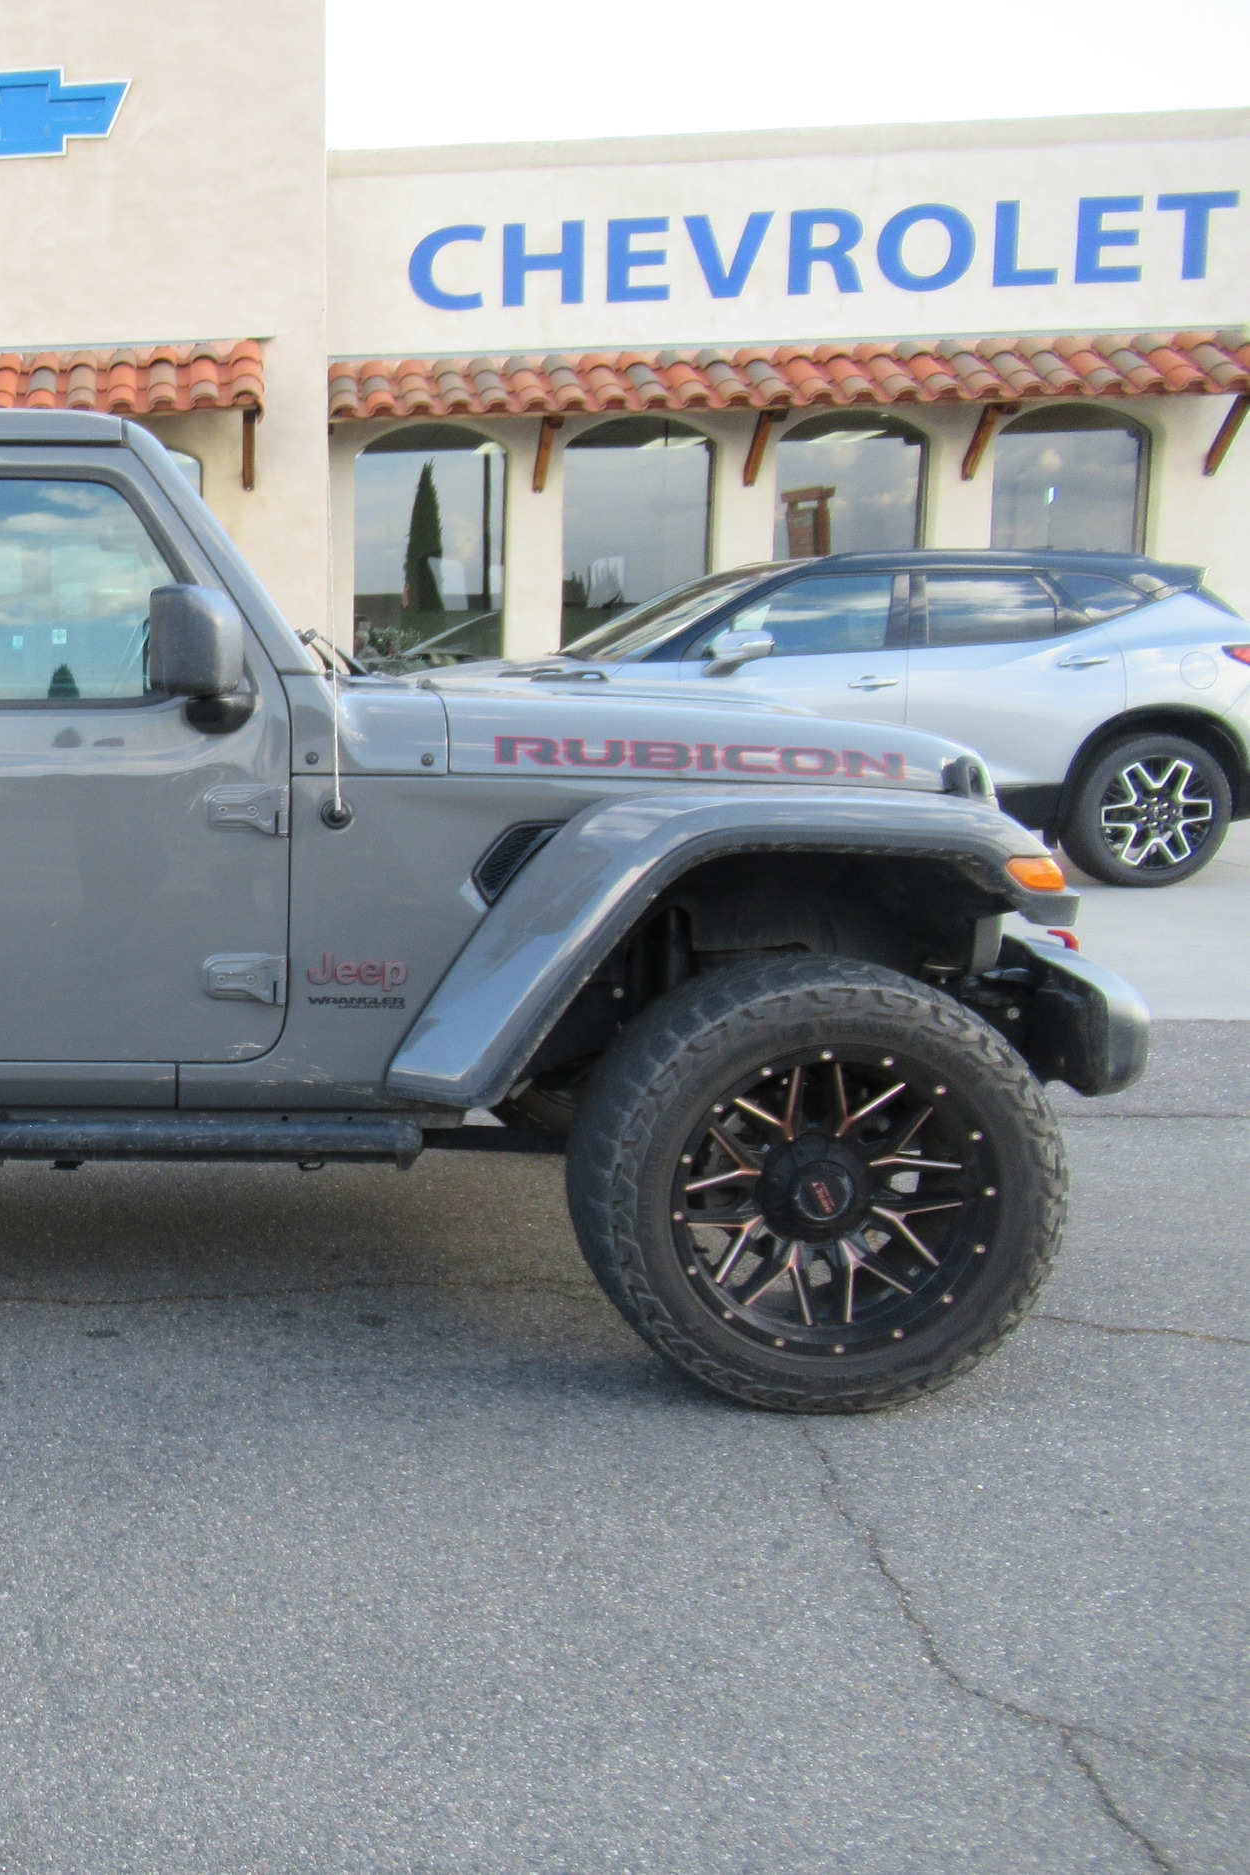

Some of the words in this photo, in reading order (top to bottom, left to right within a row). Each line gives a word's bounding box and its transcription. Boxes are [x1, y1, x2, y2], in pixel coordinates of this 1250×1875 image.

[408, 190, 1240, 311] CHEVROLET
[494, 735, 907, 781] RUBICON
[307, 952, 409, 992] Jeep
[307, 996, 406, 1005] WRANGLER
